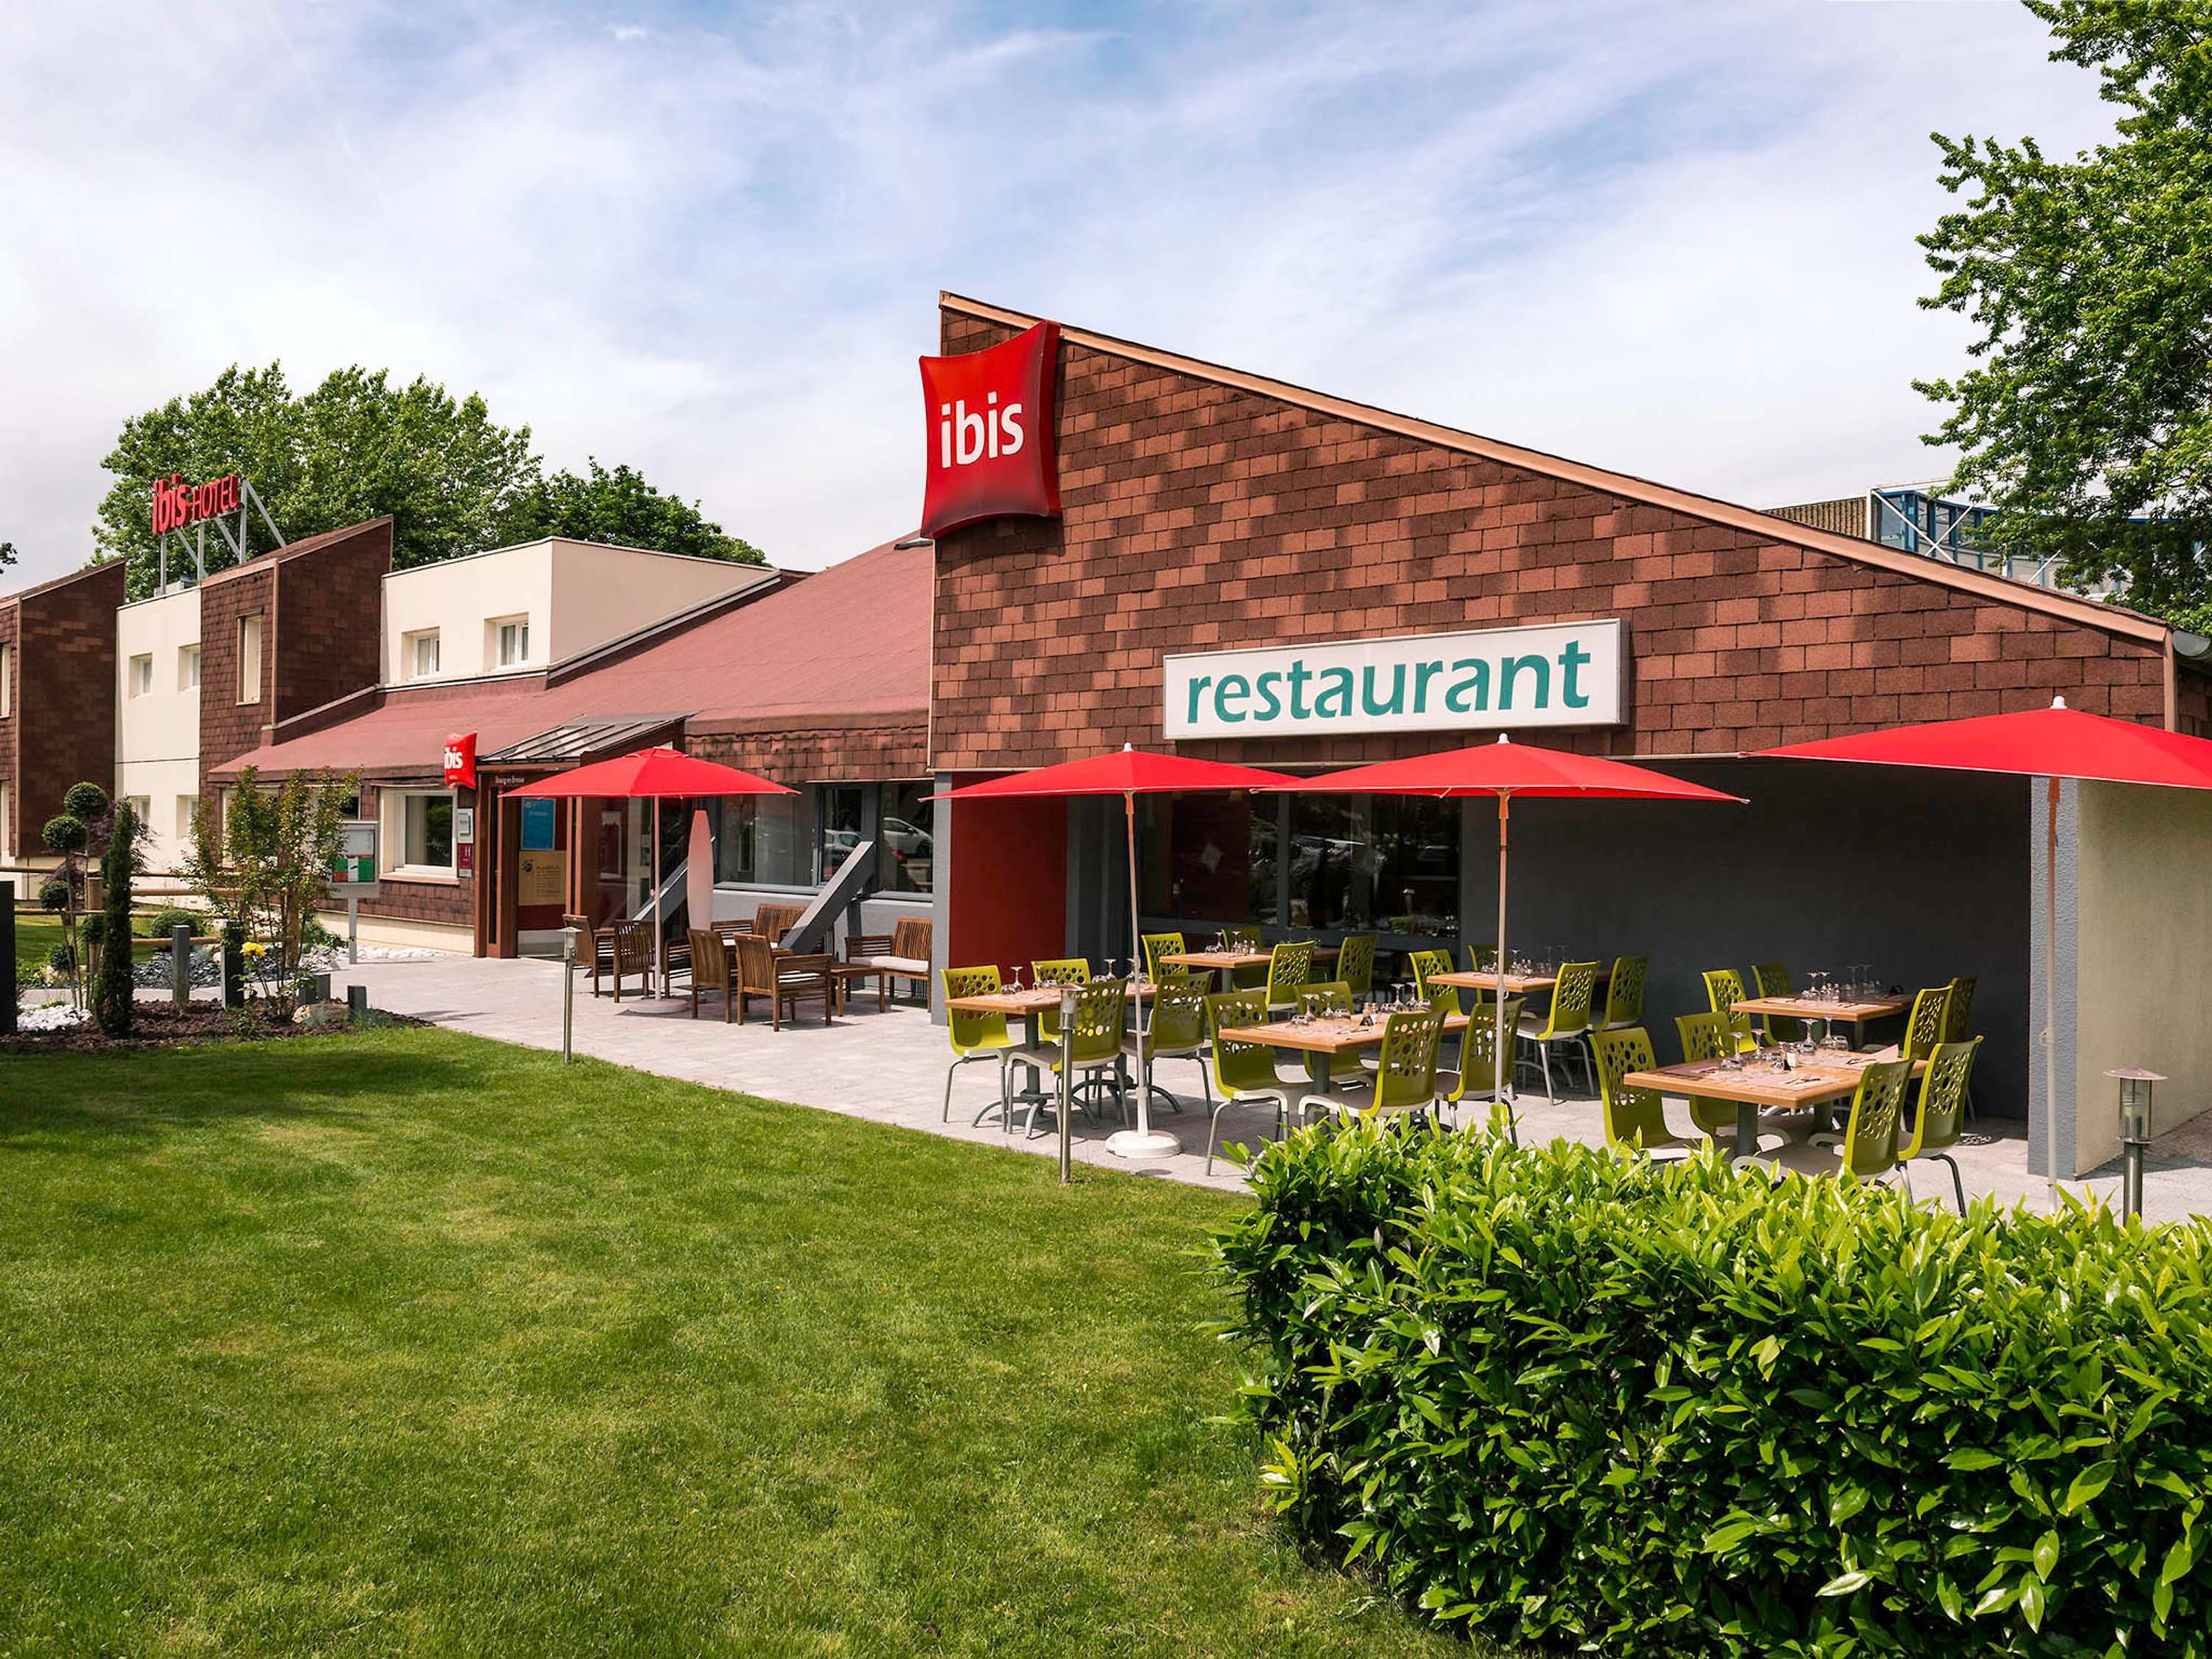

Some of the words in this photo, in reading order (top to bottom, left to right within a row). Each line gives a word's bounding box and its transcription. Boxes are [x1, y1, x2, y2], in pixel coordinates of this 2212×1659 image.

[941, 391, 1024, 469] ibis
[152, 473, 189, 535] ibis
[192, 474, 238, 521] HOTEL
[1186, 639, 1591, 724] restaurant
